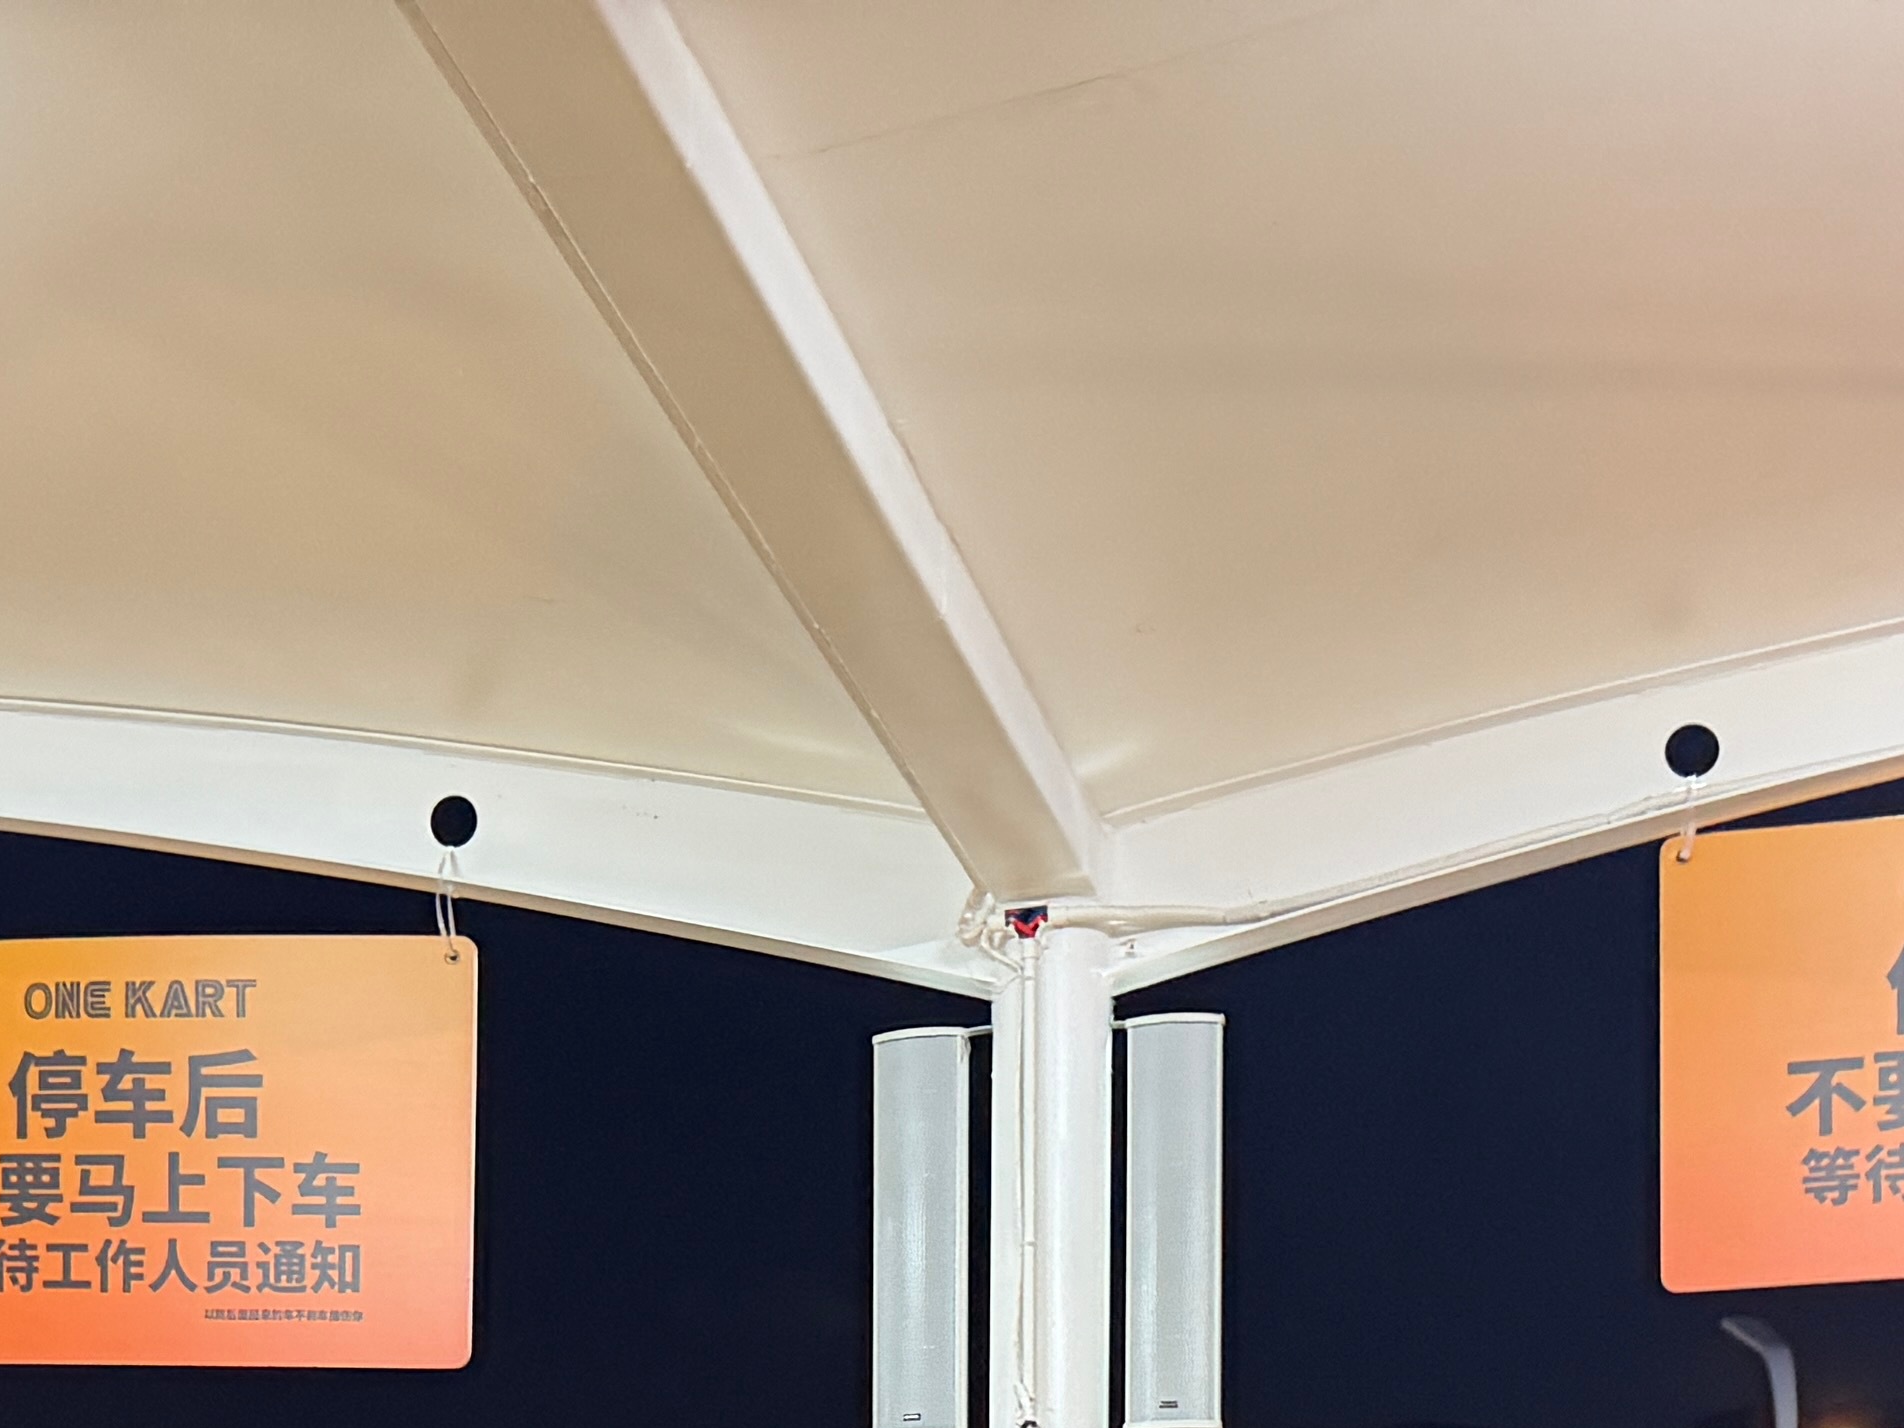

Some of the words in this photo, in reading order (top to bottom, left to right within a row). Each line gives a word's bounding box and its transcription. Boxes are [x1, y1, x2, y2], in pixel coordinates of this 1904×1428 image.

[24, 979, 112, 1020] ONE
[124, 978, 258, 1019] KART
[7, 1048, 264, 1140] 停车后
